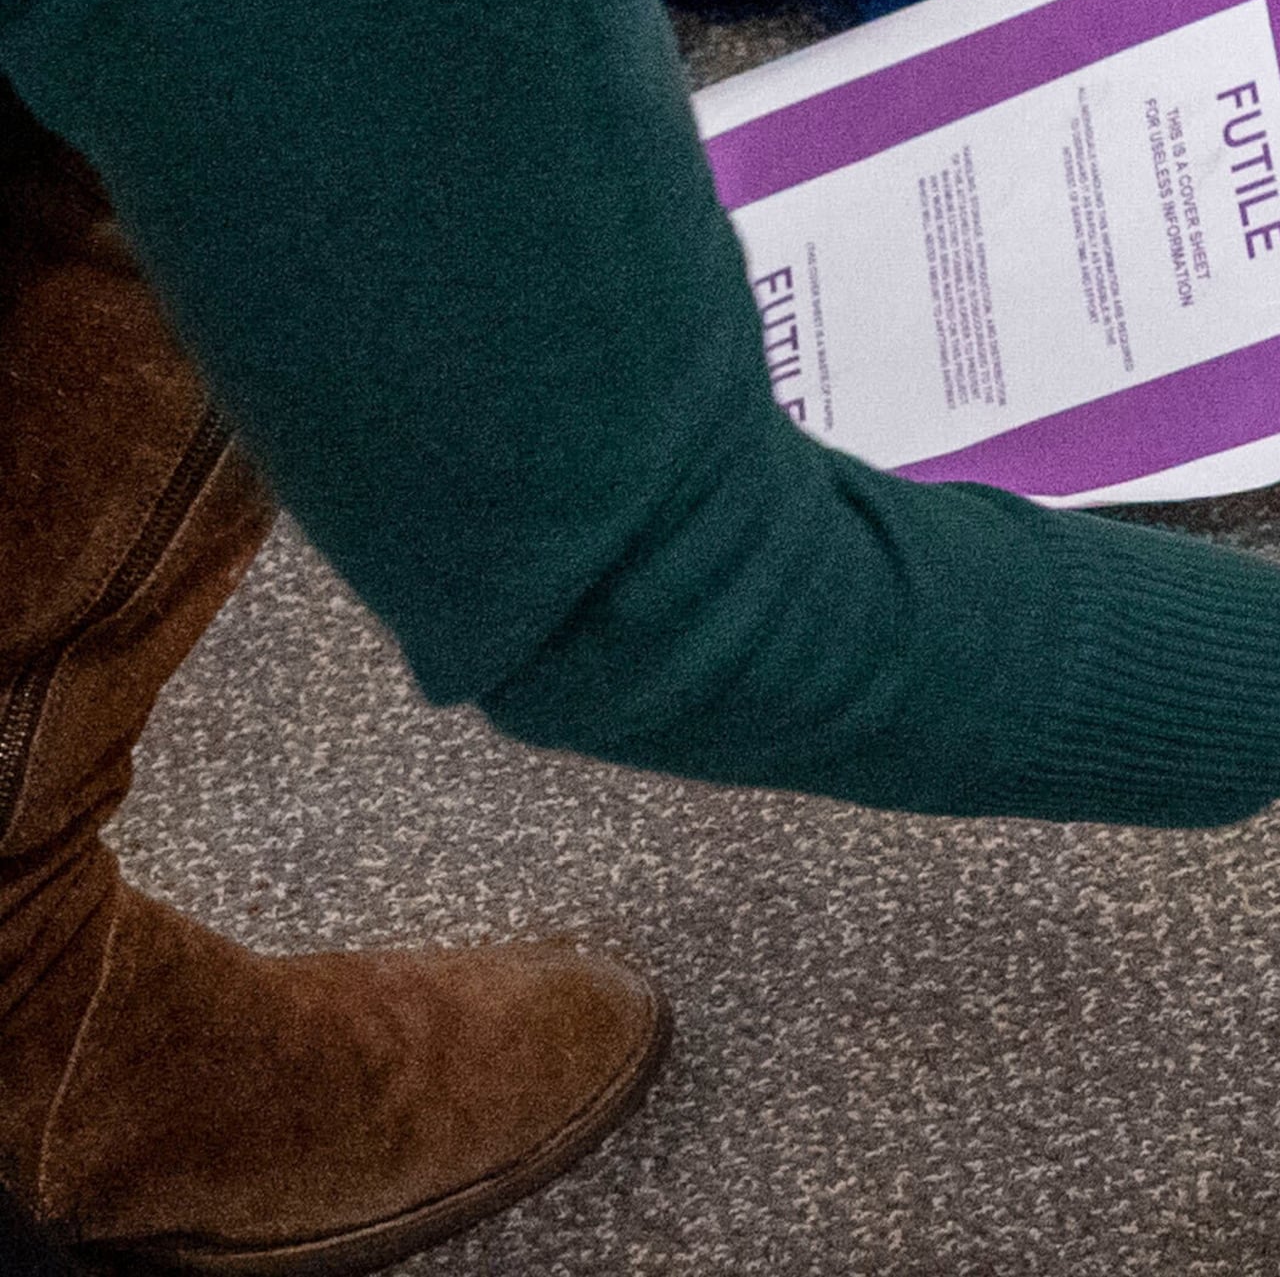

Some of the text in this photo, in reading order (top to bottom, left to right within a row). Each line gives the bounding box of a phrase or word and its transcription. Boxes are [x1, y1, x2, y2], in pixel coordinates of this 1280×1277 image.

[1141, 97, 1196, 307] FOR USELESS INFORMATION
[1164, 107, 1211, 281] THIS IS A COVER SHEET
